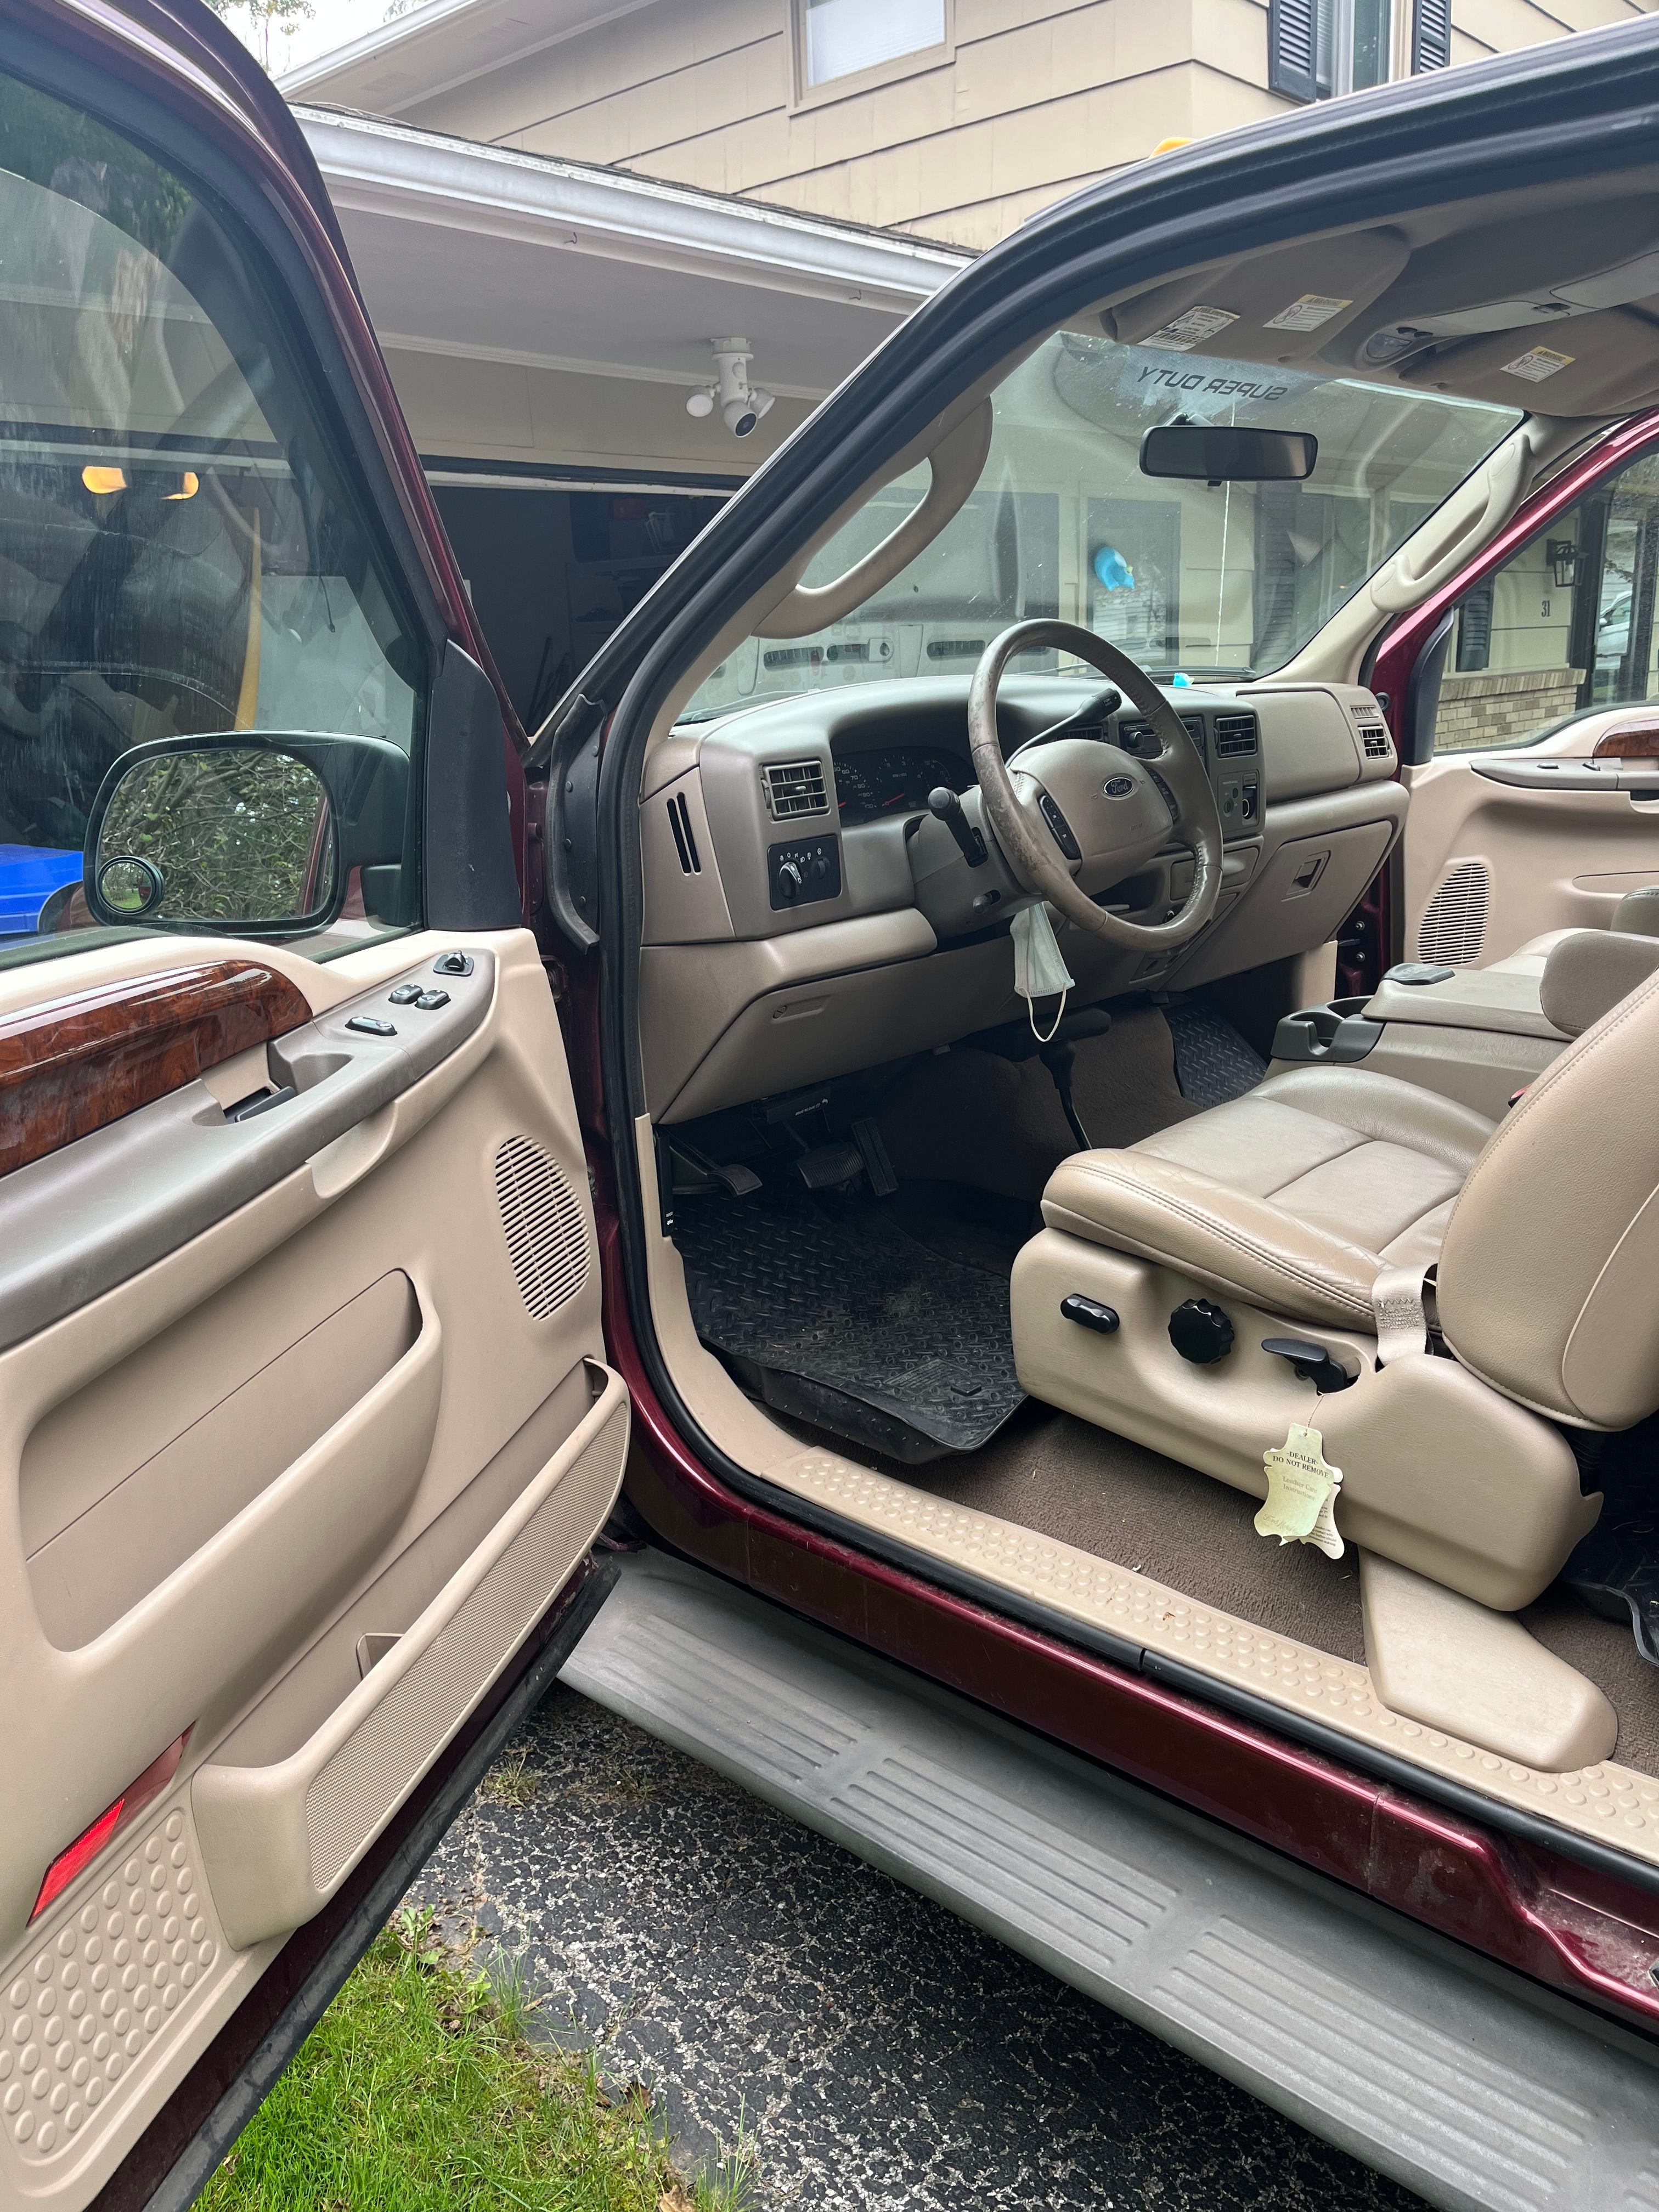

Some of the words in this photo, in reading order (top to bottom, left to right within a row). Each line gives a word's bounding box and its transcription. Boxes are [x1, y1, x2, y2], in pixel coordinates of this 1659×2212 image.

[1541, 600, 1550, 617] 31
[1110, 779, 1129, 794] Ford
[1286, 1458, 1301, 1468] NOT
[1302, 1464, 1329, 1479] REMOVE
[1283, 1476, 1305, 1488] Leather
[1305, 1483, 1317, 1493] Care
[1283, 1483, 1315, 1500] Instructions
